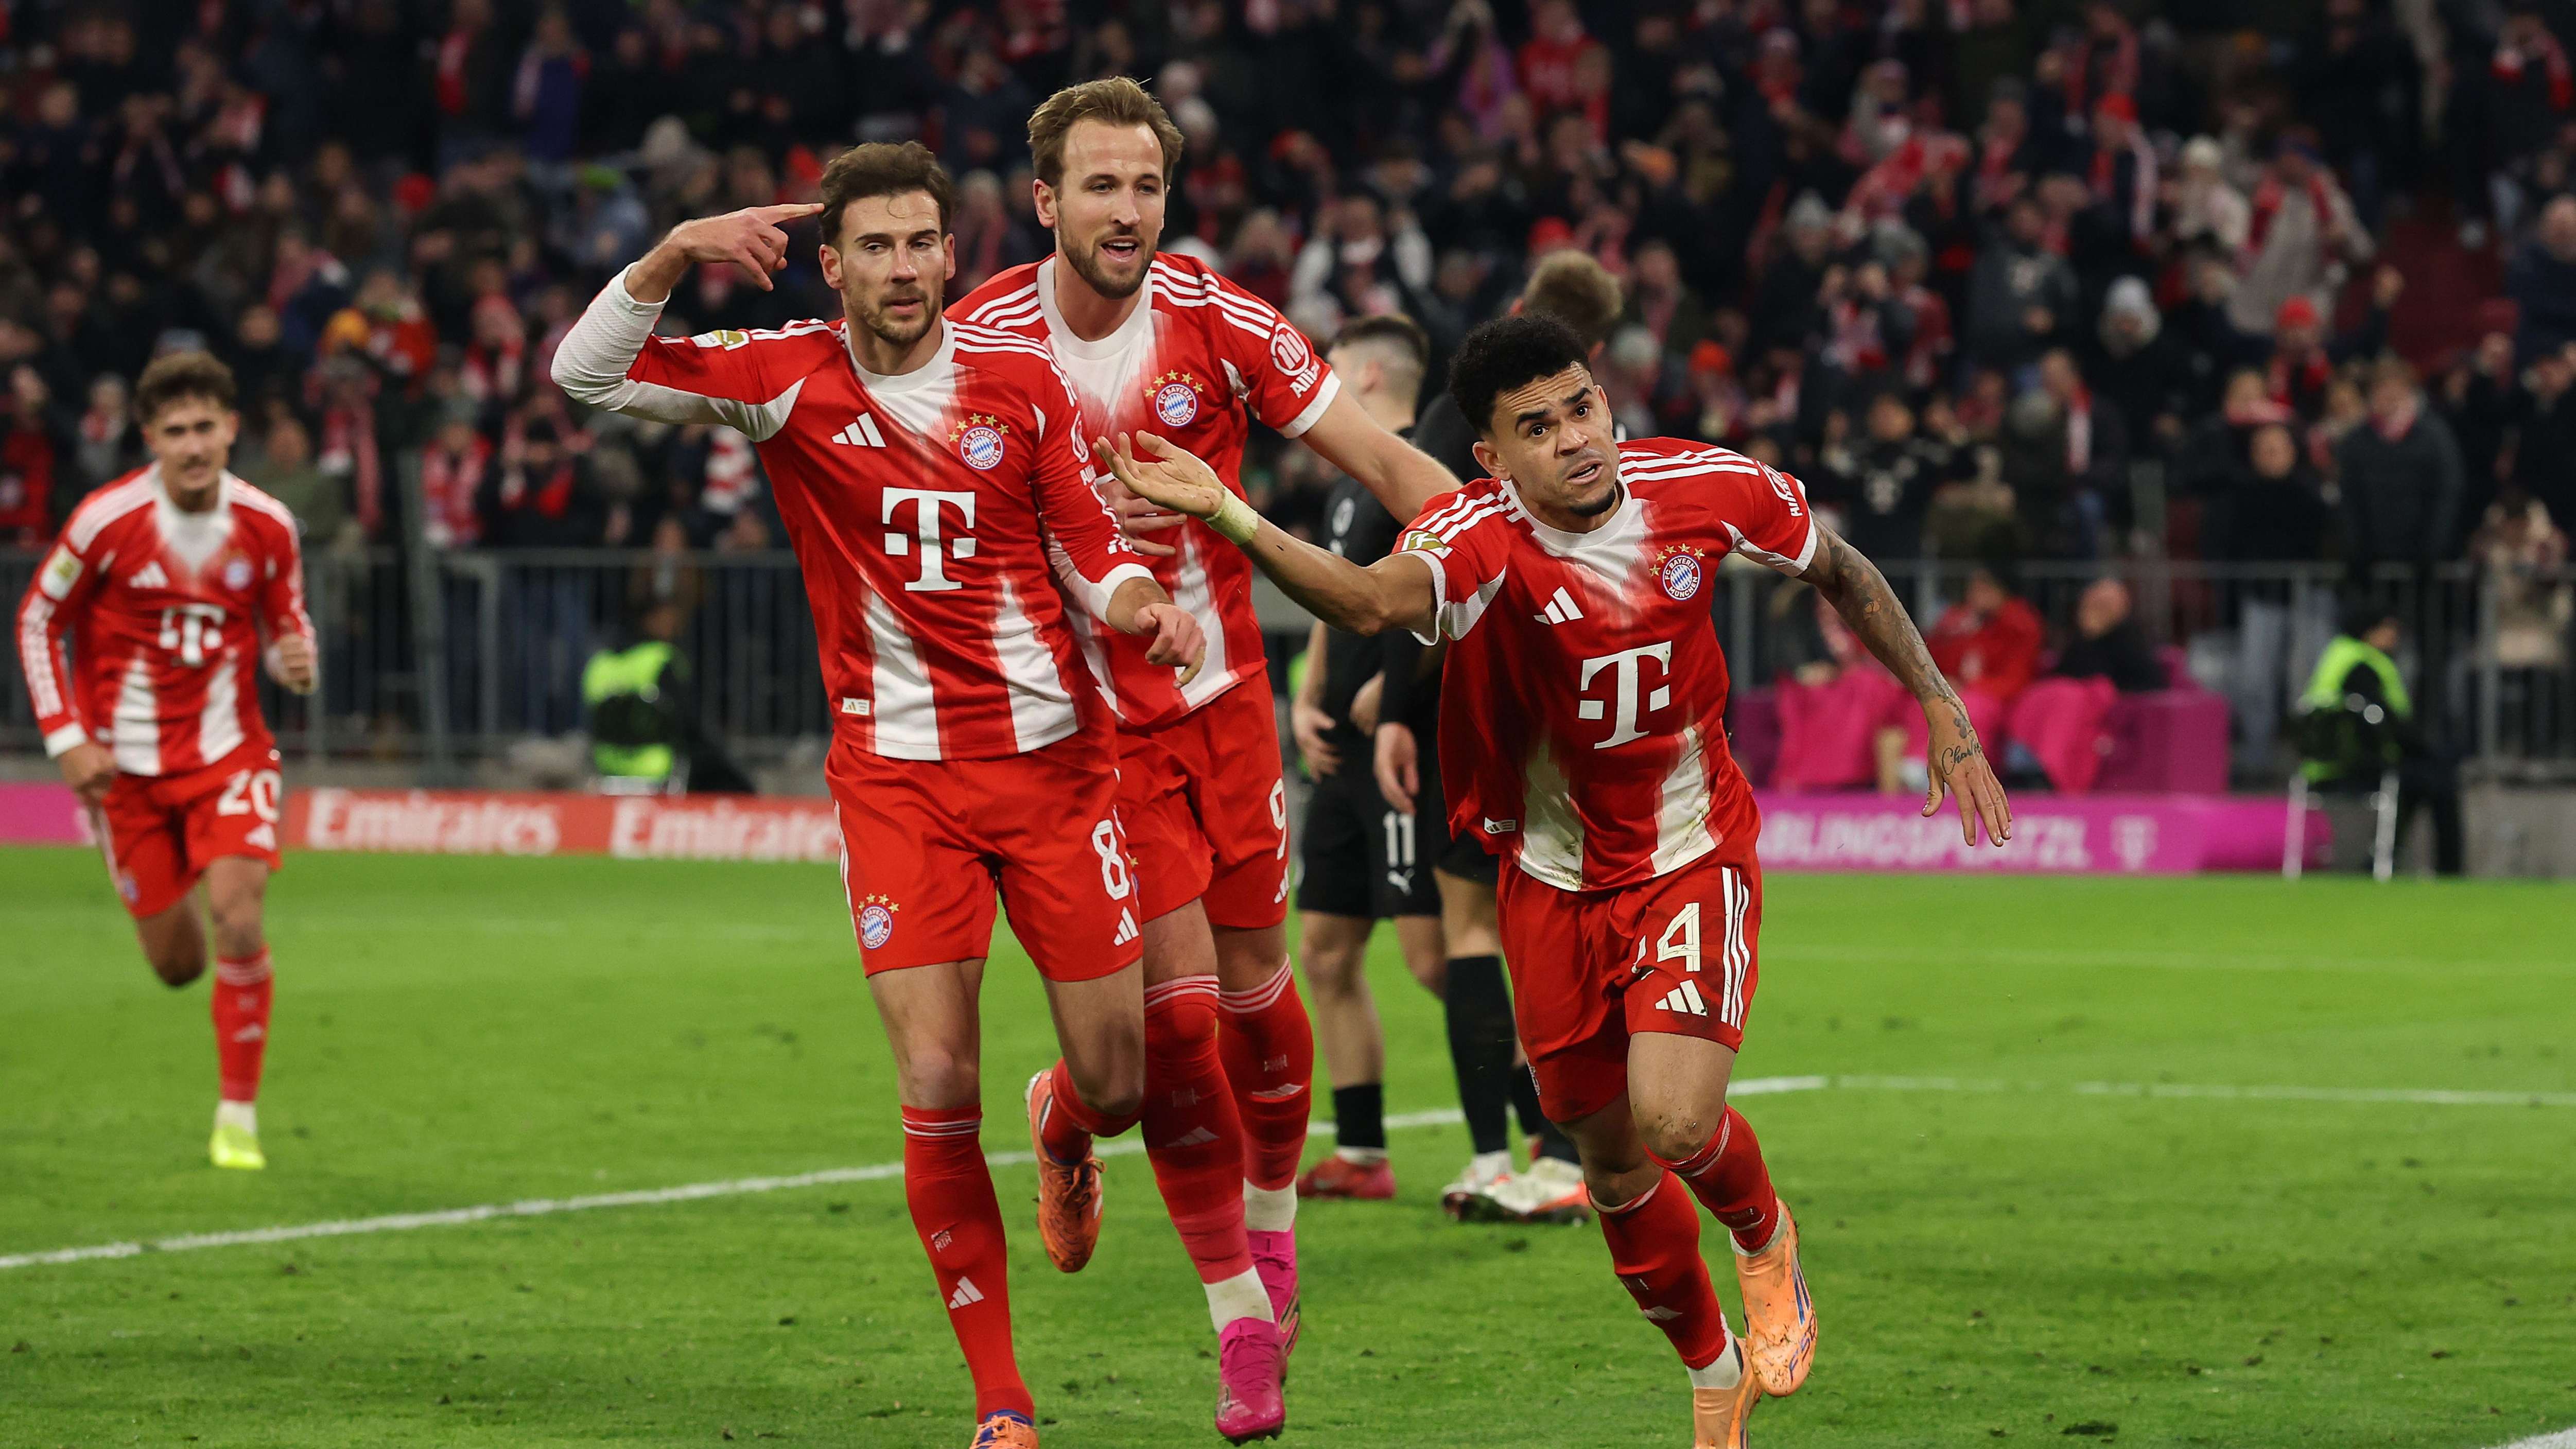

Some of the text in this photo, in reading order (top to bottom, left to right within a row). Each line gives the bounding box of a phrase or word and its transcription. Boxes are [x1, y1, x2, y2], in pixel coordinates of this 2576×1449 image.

[1159, 387, 1193, 404] FC BAYERN
[964, 430, 999, 448] FC BAYERN
[882, 487, 977, 591] T
[1665, 557, 1696, 580] FC BAYERN
[159, 603, 227, 666] T
[1578, 640, 1672, 749] T
[217, 769, 282, 823] 20
[306, 787, 560, 856] Emirates
[1269, 778, 1286, 860] 9
[610, 797, 841, 861] Emirate
[1092, 819, 1130, 901] 8
[1383, 810, 1415, 867] 11
